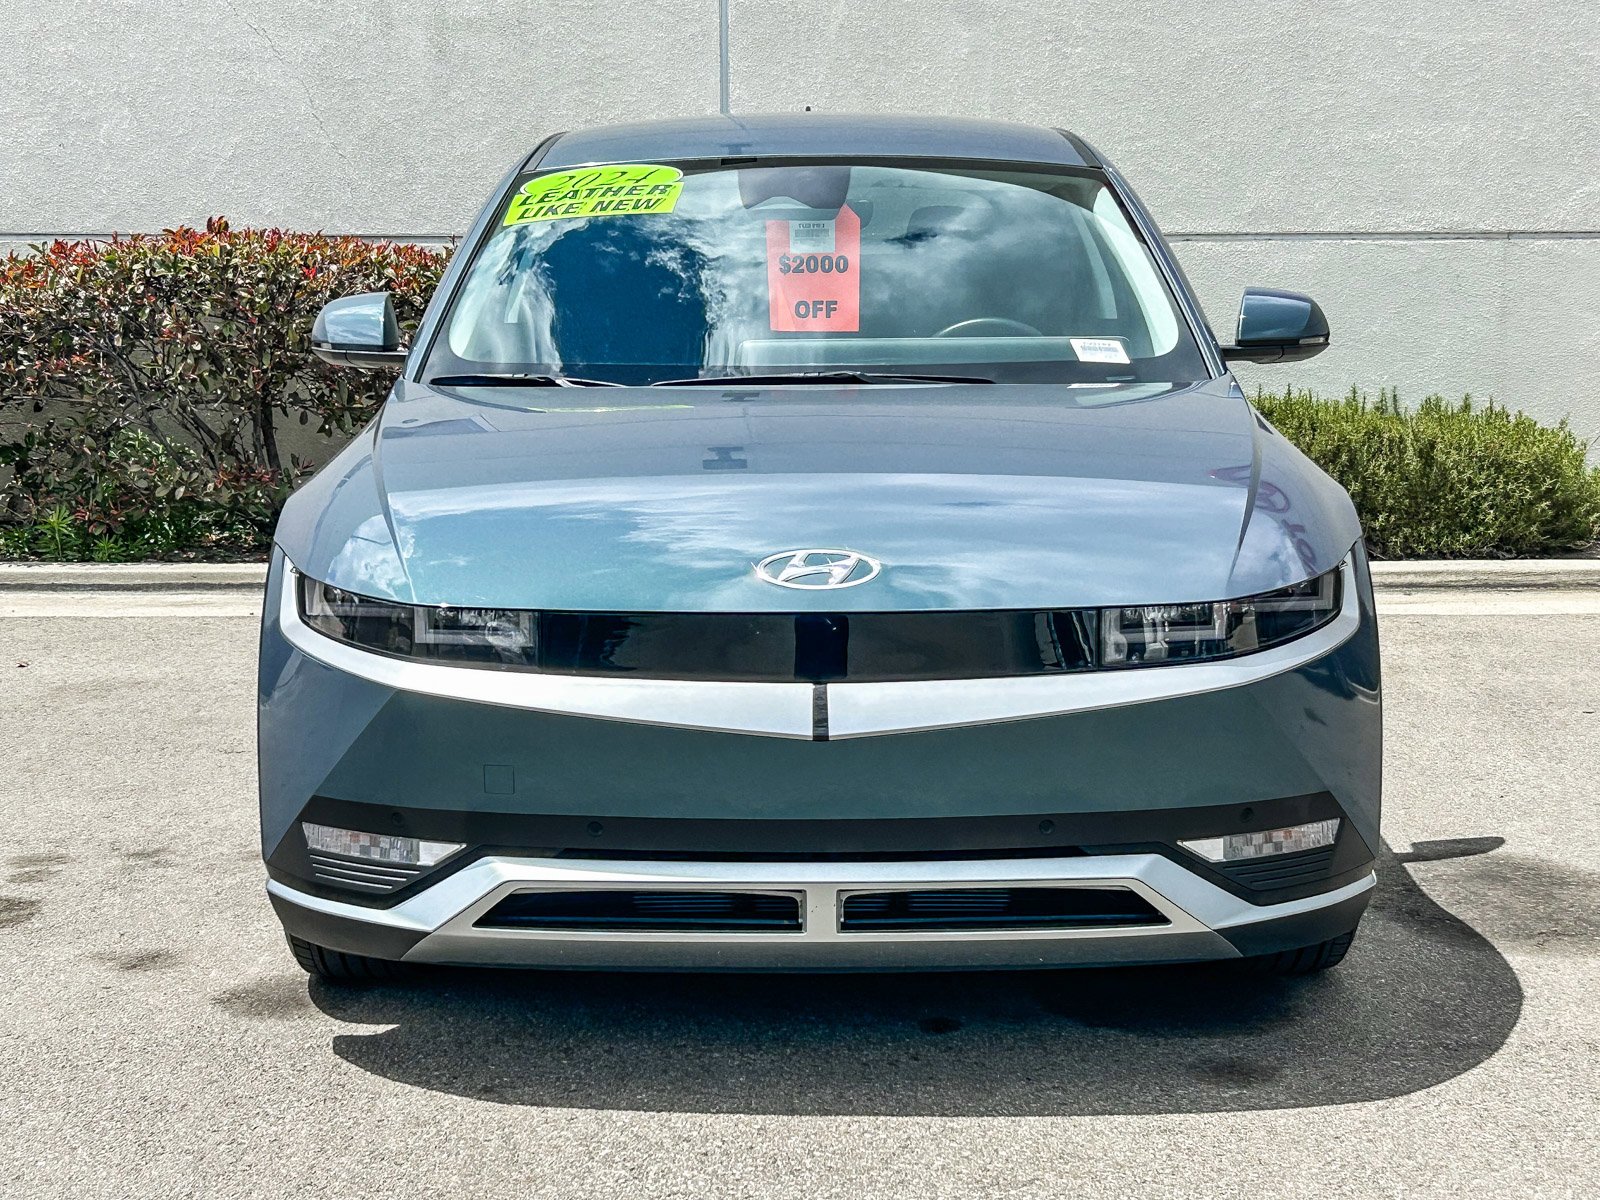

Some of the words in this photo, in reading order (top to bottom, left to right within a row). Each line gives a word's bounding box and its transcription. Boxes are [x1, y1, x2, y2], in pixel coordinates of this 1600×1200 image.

[544, 169, 660, 192] 2024
[518, 184, 674, 206] LEATHER
[517, 202, 585, 221] LIKE
[590, 198, 662, 213] NEW
[779, 253, 849, 275] $2000
[794, 300, 838, 319] OFF
